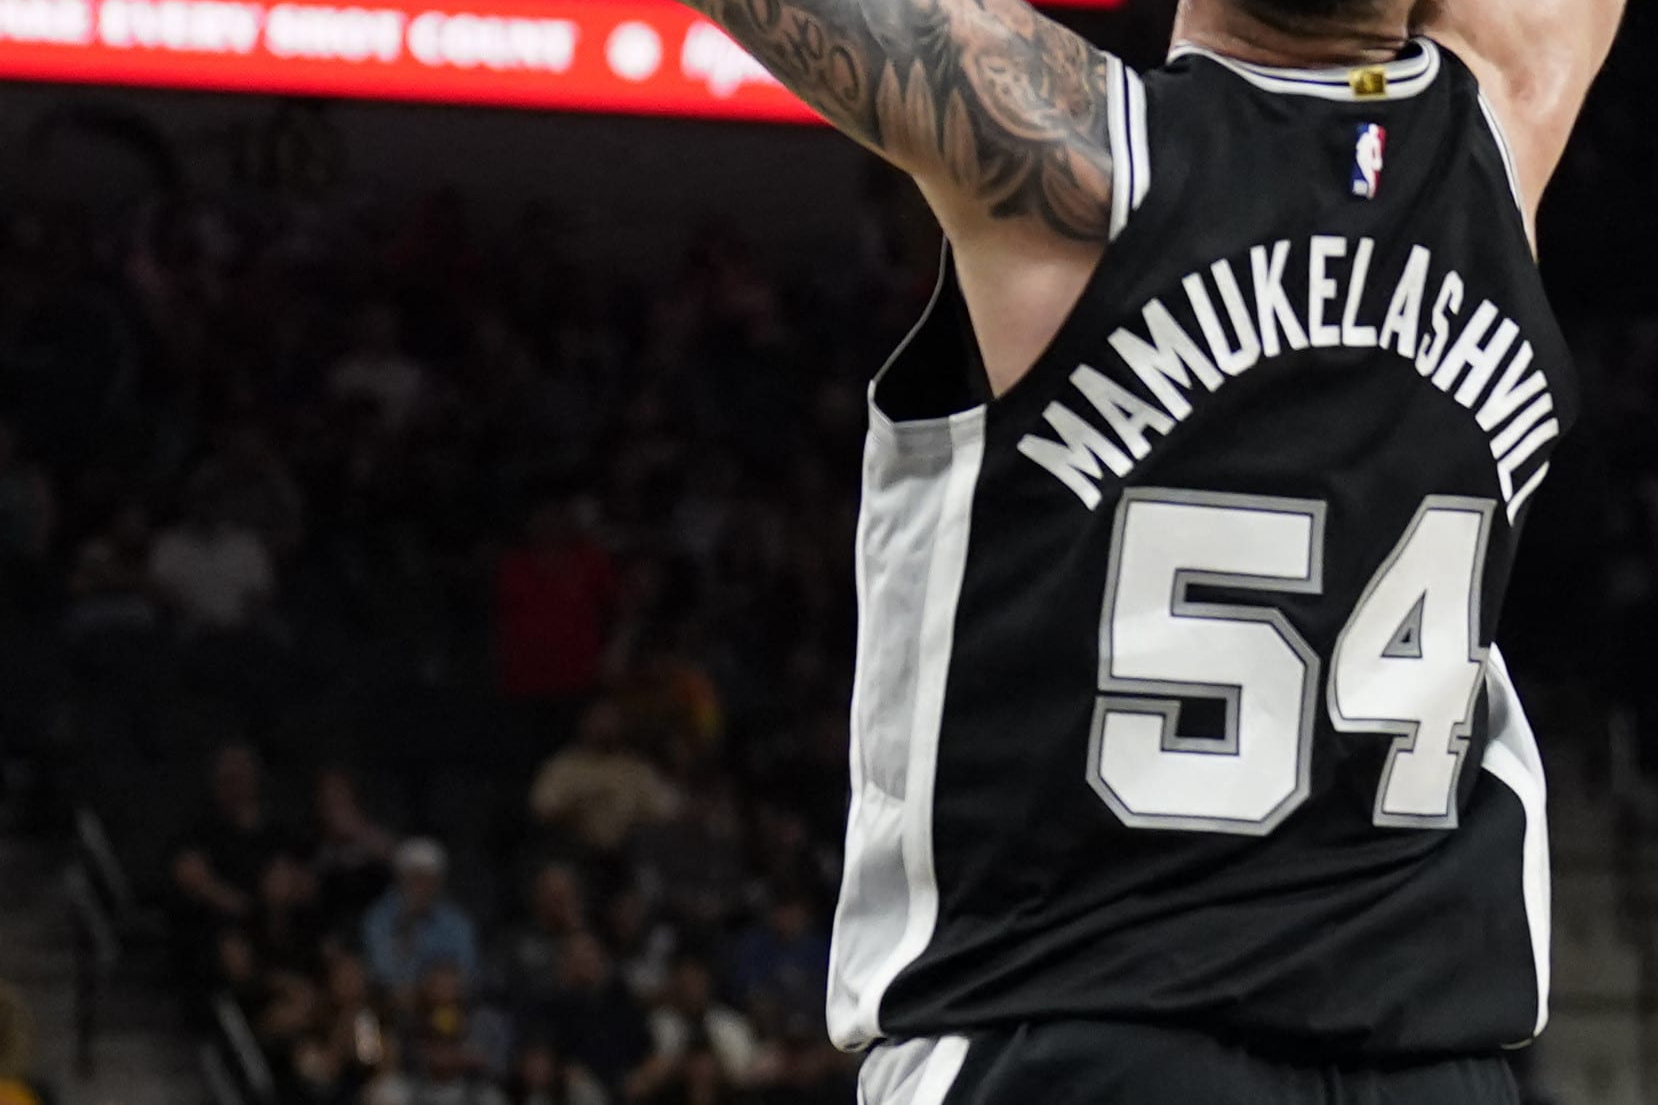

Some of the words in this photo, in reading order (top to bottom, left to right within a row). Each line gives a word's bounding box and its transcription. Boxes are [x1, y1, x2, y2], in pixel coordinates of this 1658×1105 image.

[265, 3, 405, 64] SHOT
[407, 10, 580, 73] COUNT
[1085, 487, 1497, 837] 54
